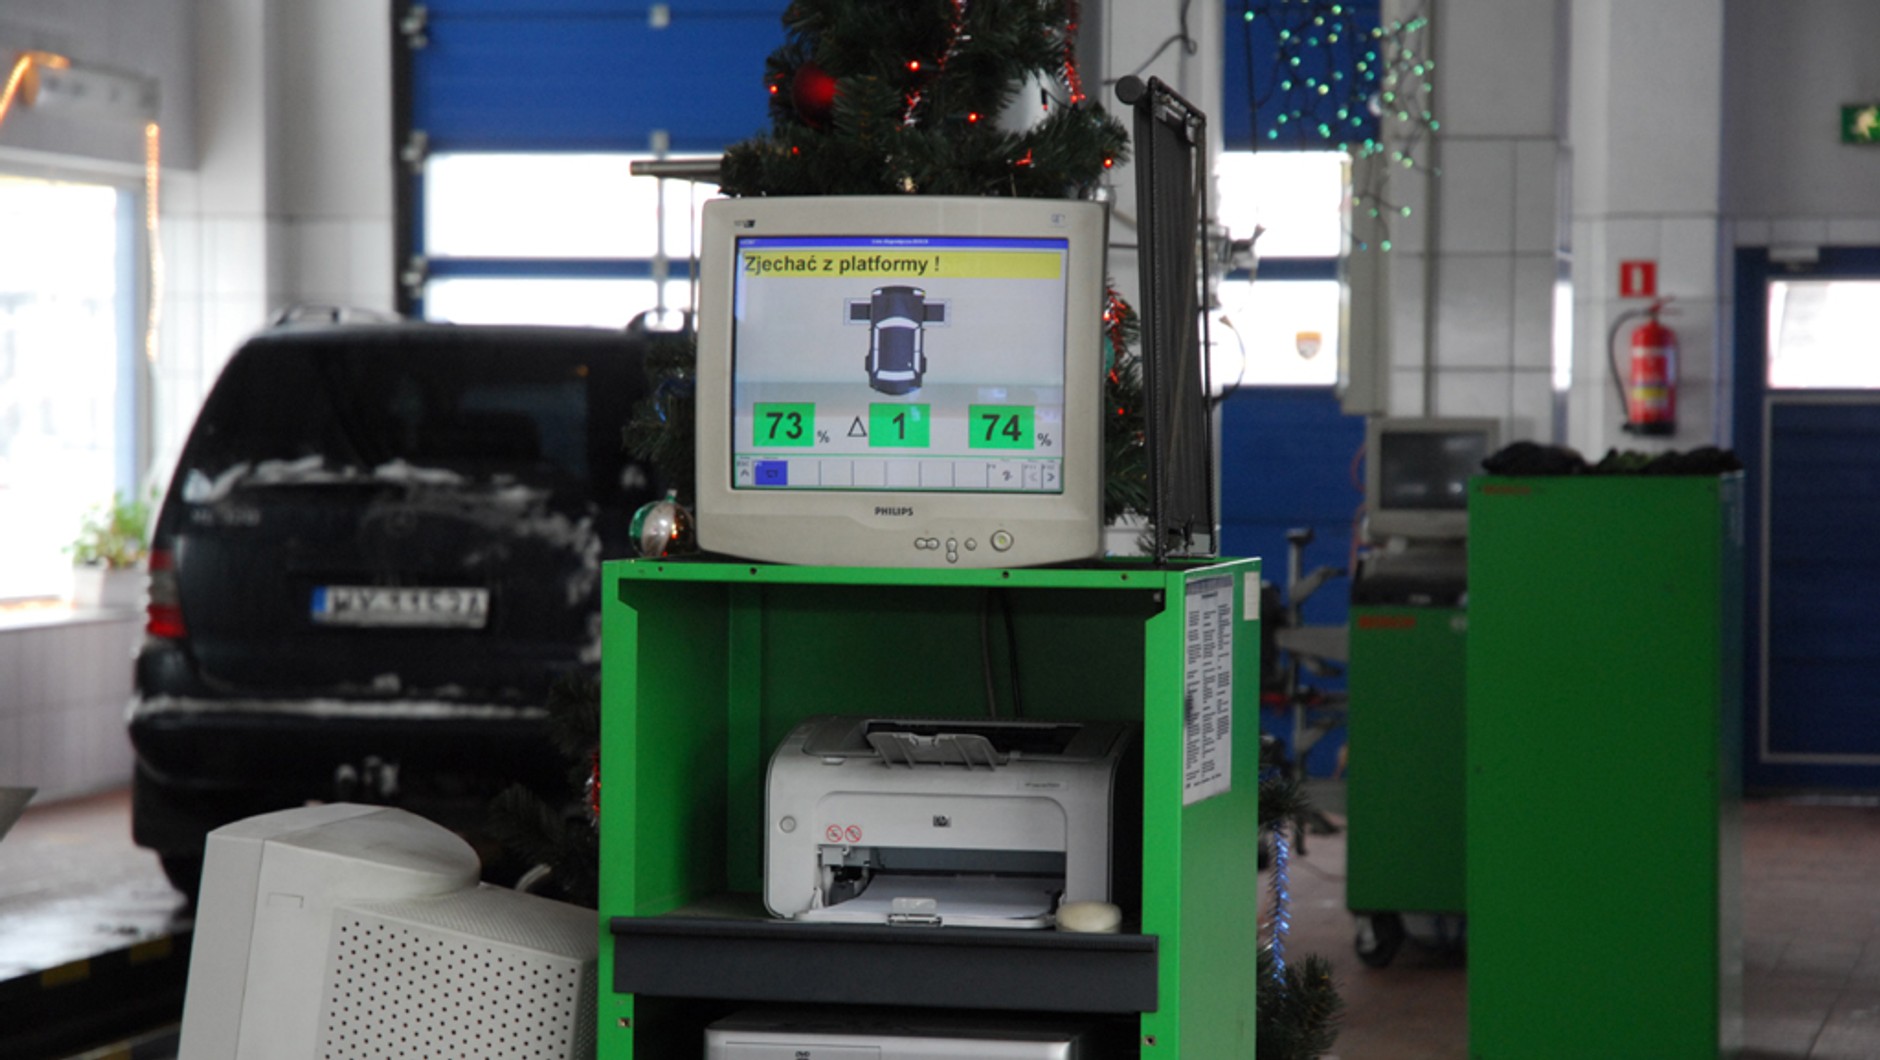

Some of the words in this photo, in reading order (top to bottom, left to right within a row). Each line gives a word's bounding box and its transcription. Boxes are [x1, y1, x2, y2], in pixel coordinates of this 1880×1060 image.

[744, 255, 817, 275] Zjechać
[822, 259, 833, 271] z
[839, 255, 929, 276] platformy
[934, 255, 940, 272] !
[766, 411, 803, 439] 73
[817, 430, 830, 443] %
[892, 412, 905, 439] 1
[982, 414, 1022, 442] 74
[1037, 432, 1053, 447] %
[874, 506, 914, 517] PHILIPS
